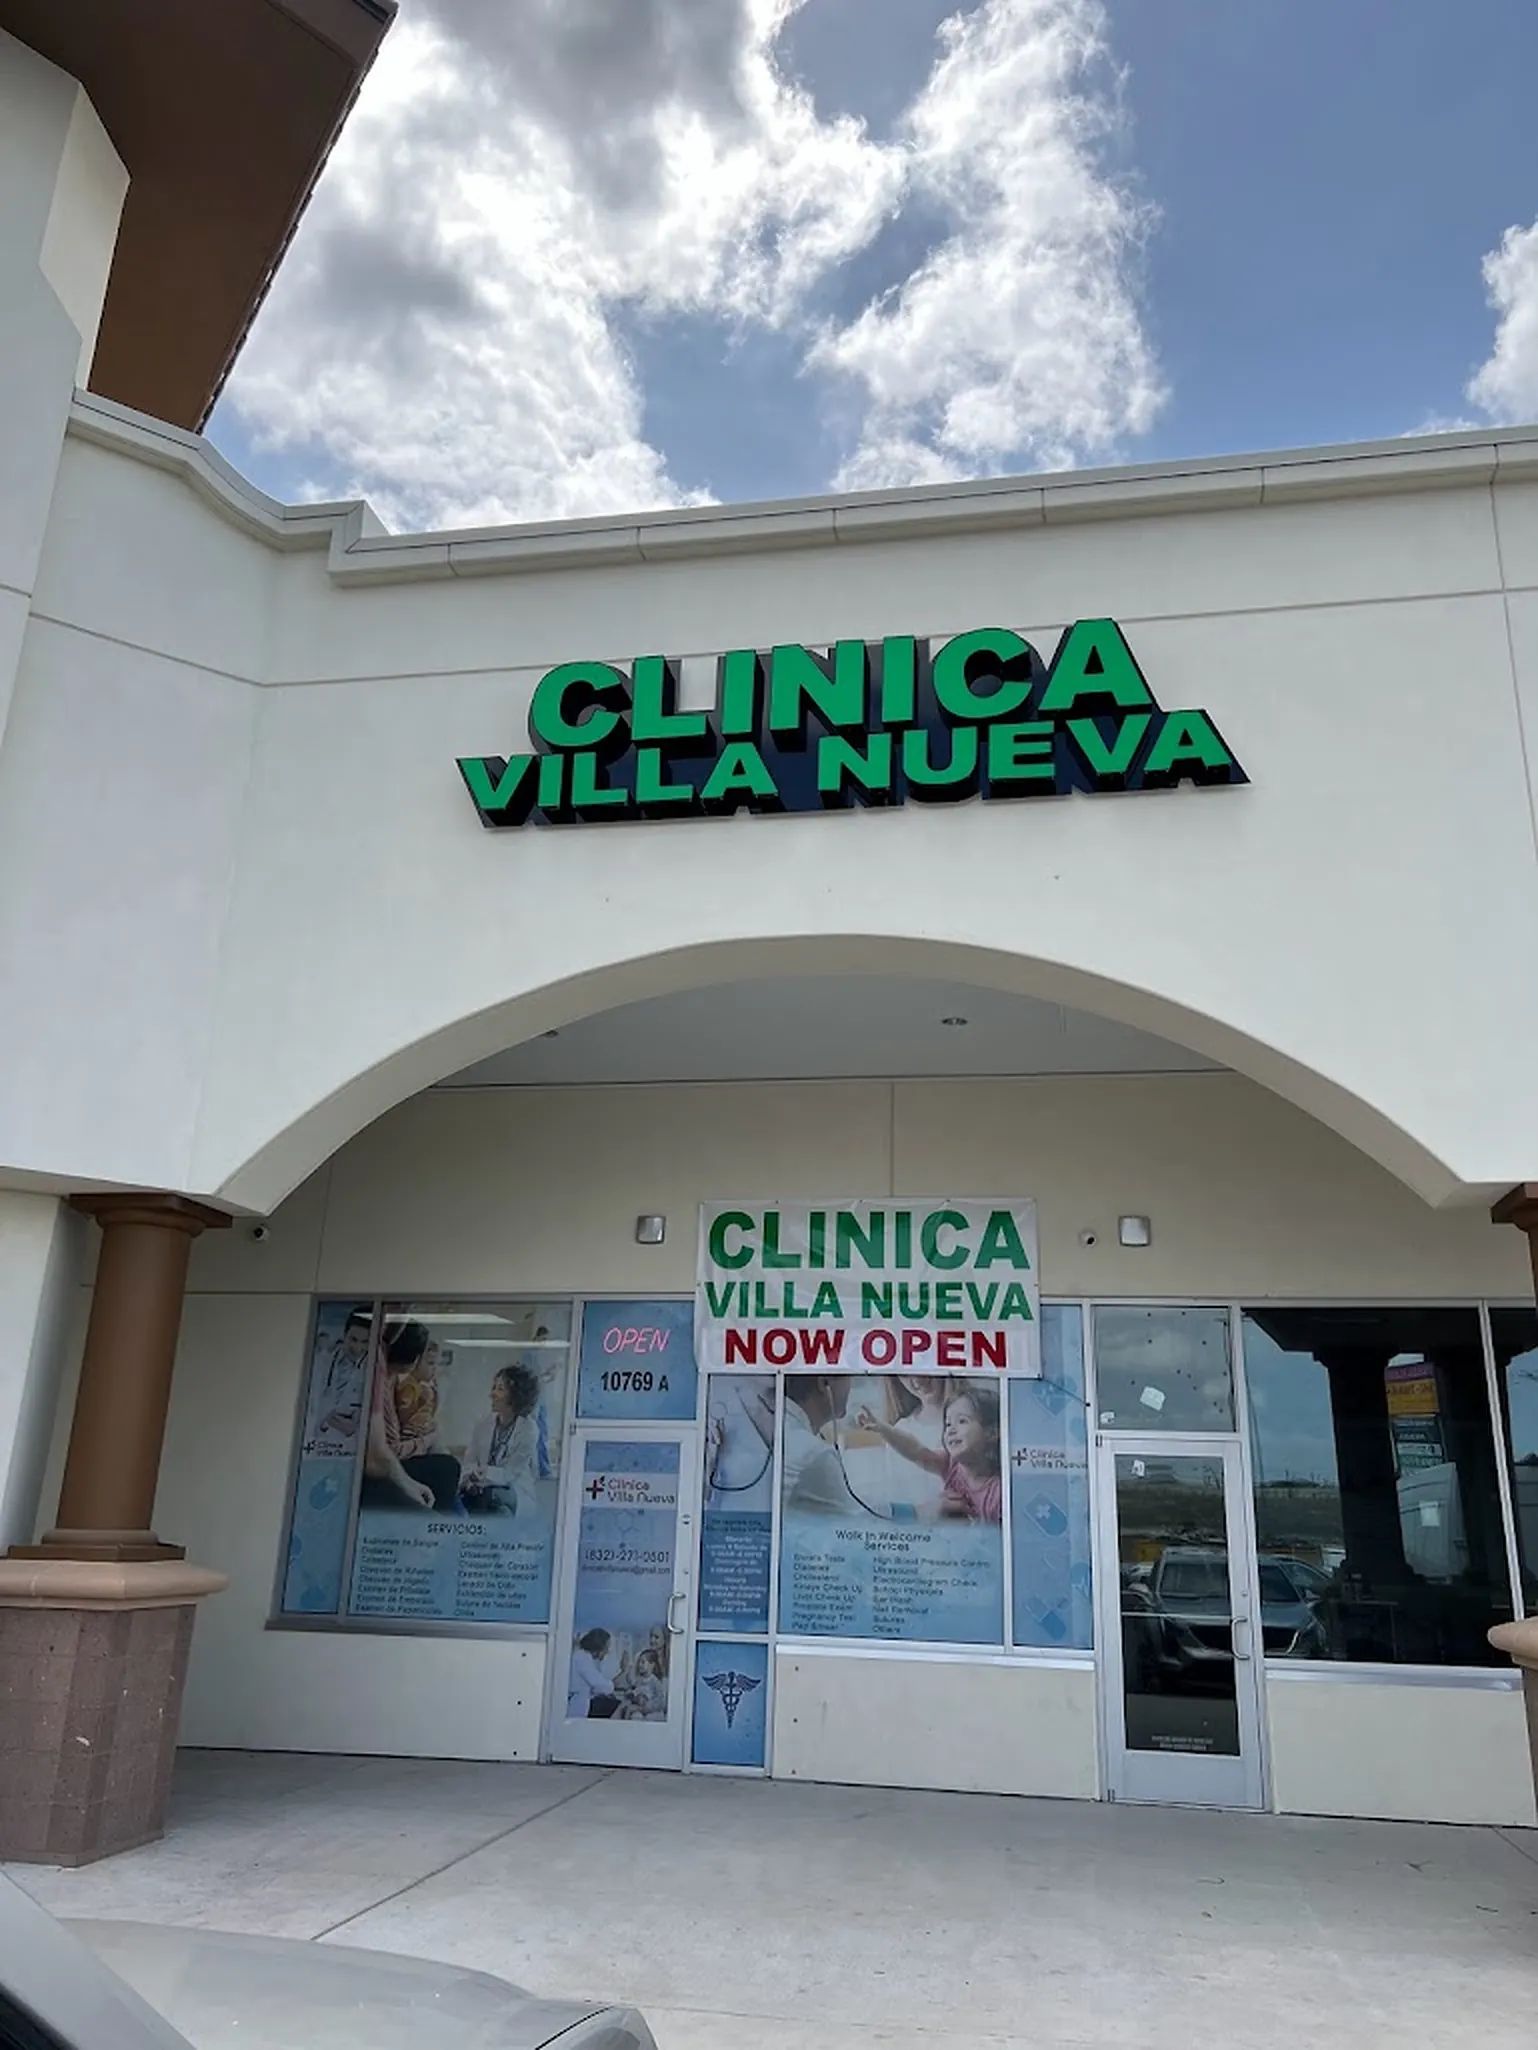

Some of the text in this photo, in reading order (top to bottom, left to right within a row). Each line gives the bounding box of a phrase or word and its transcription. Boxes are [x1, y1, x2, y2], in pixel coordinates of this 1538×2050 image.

[531, 618, 1153, 748] CLINICA
[461, 709, 1233, 811] VILLA NUEVA
[708, 1210, 1031, 1270] CLINICA
[703, 1281, 1033, 1321] VILLA NUEVA
[602, 1326, 671, 1355] OPEN
[724, 1328, 1008, 1367] NOW OPEN
[600, 1371, 669, 1392] 10769 A
[608, 1477, 651, 1491] Clinica
[607, 1491, 675, 1504] Villa Nueva
[427, 1523, 487, 1536] SERVICIOS:
[835, 1529, 864, 1540] Walk
[879, 1531, 931, 1543] Welcome
[864, 1541, 910, 1551] Services
